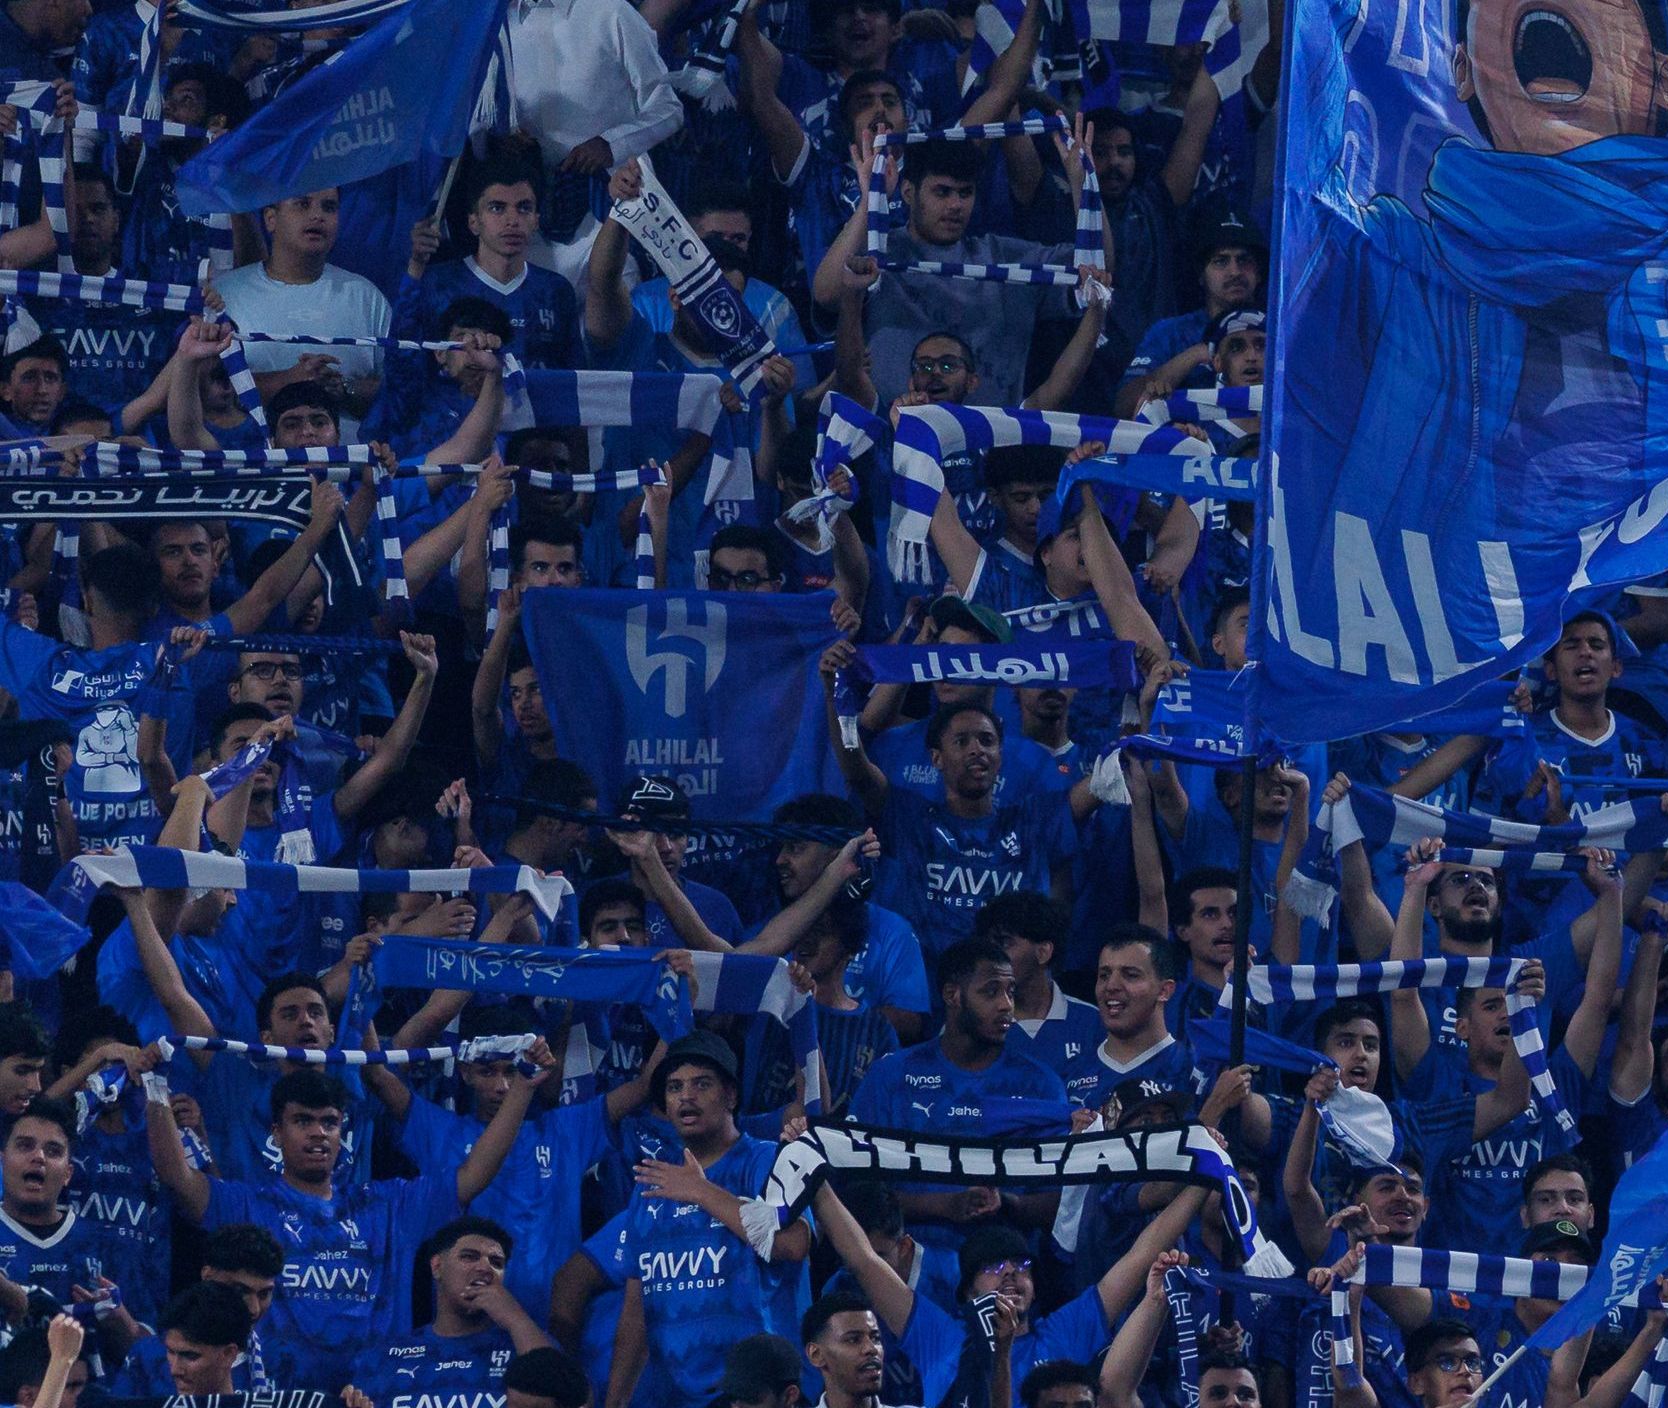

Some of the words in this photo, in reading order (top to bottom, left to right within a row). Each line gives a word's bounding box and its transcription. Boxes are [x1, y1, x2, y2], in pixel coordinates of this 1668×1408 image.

[911, 652, 1070, 684] الهلال
[625, 739, 724, 765] ALHILAL
[766, 1127, 1199, 1210] ALHILAL
[281, 1264, 370, 1290] SAVVY
[640, 1245, 728, 1279] SAVVY
